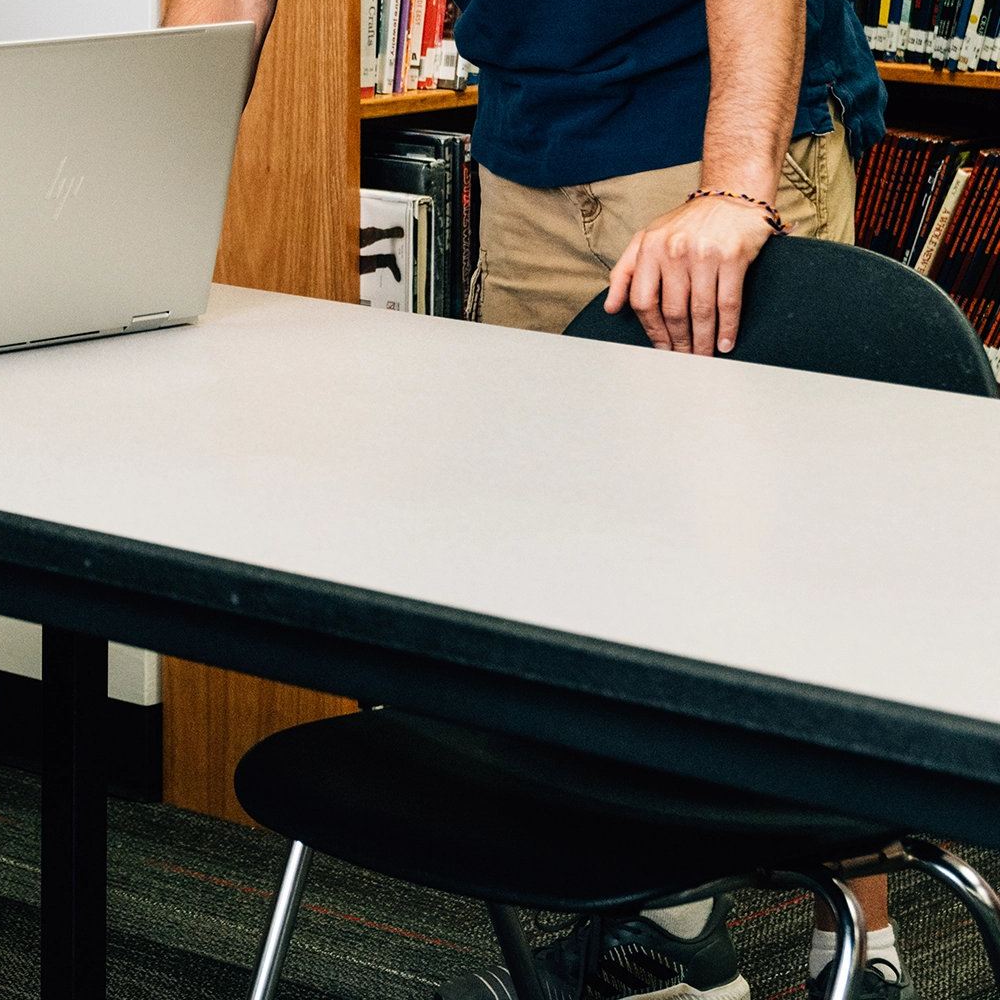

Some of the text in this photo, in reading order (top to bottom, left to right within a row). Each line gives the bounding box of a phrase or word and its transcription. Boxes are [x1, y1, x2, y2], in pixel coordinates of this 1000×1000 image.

[367, 6, 376, 46] Crafts
[952, 180, 960, 195] MACY
[930, 216, 948, 246] WHOLE
[921, 247, 933, 266] NEW
